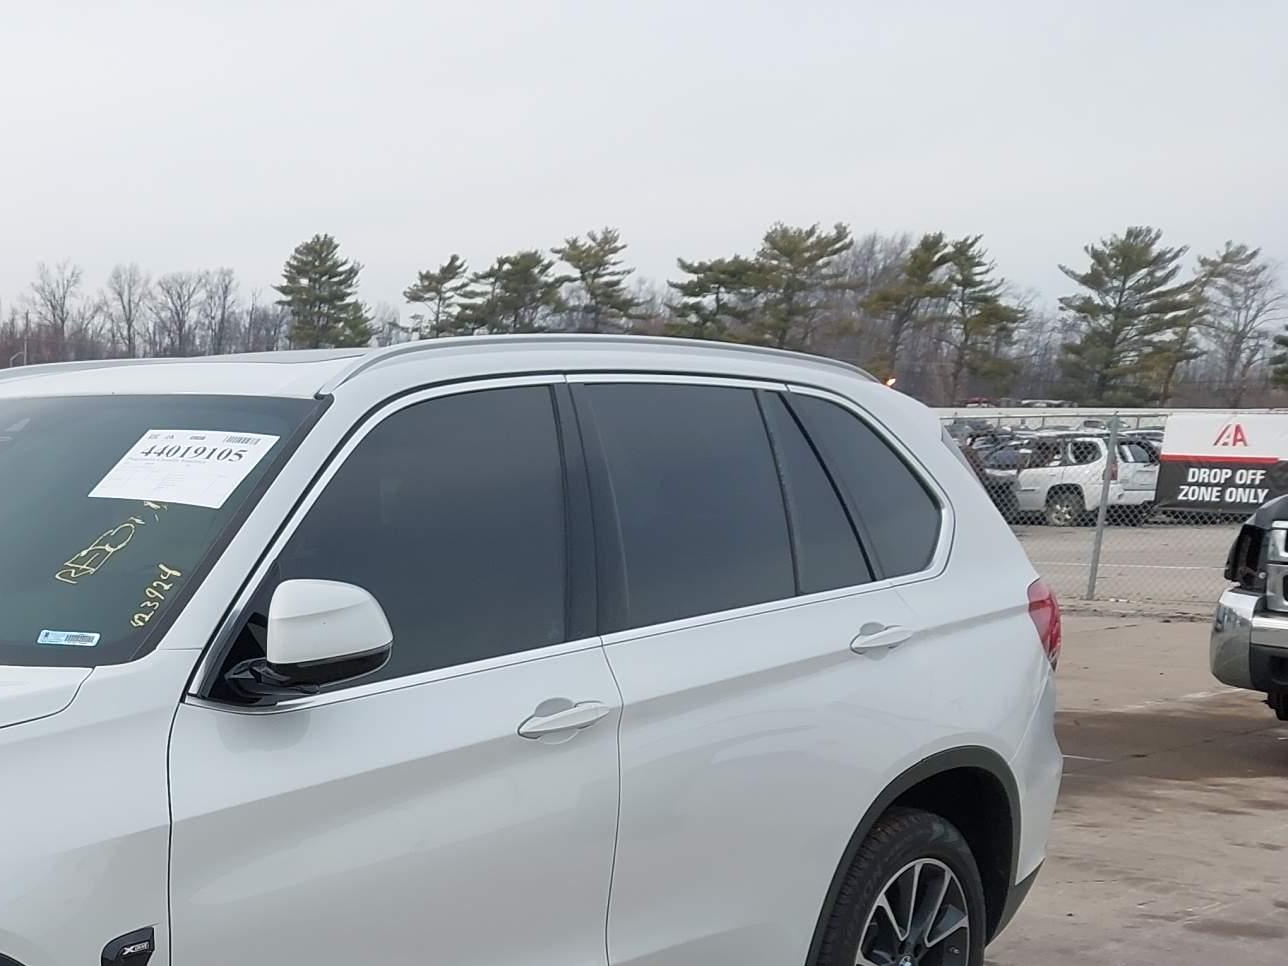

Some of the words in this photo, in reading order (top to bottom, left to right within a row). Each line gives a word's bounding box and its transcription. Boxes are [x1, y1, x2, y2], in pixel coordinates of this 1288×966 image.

[140, 444, 248, 463] 44019105
[1187, 467, 1232, 484] DROP
[1235, 469, 1267, 485] OFF
[1177, 485, 1222, 502] ZONE
[1224, 487, 1269, 504] ONLY
